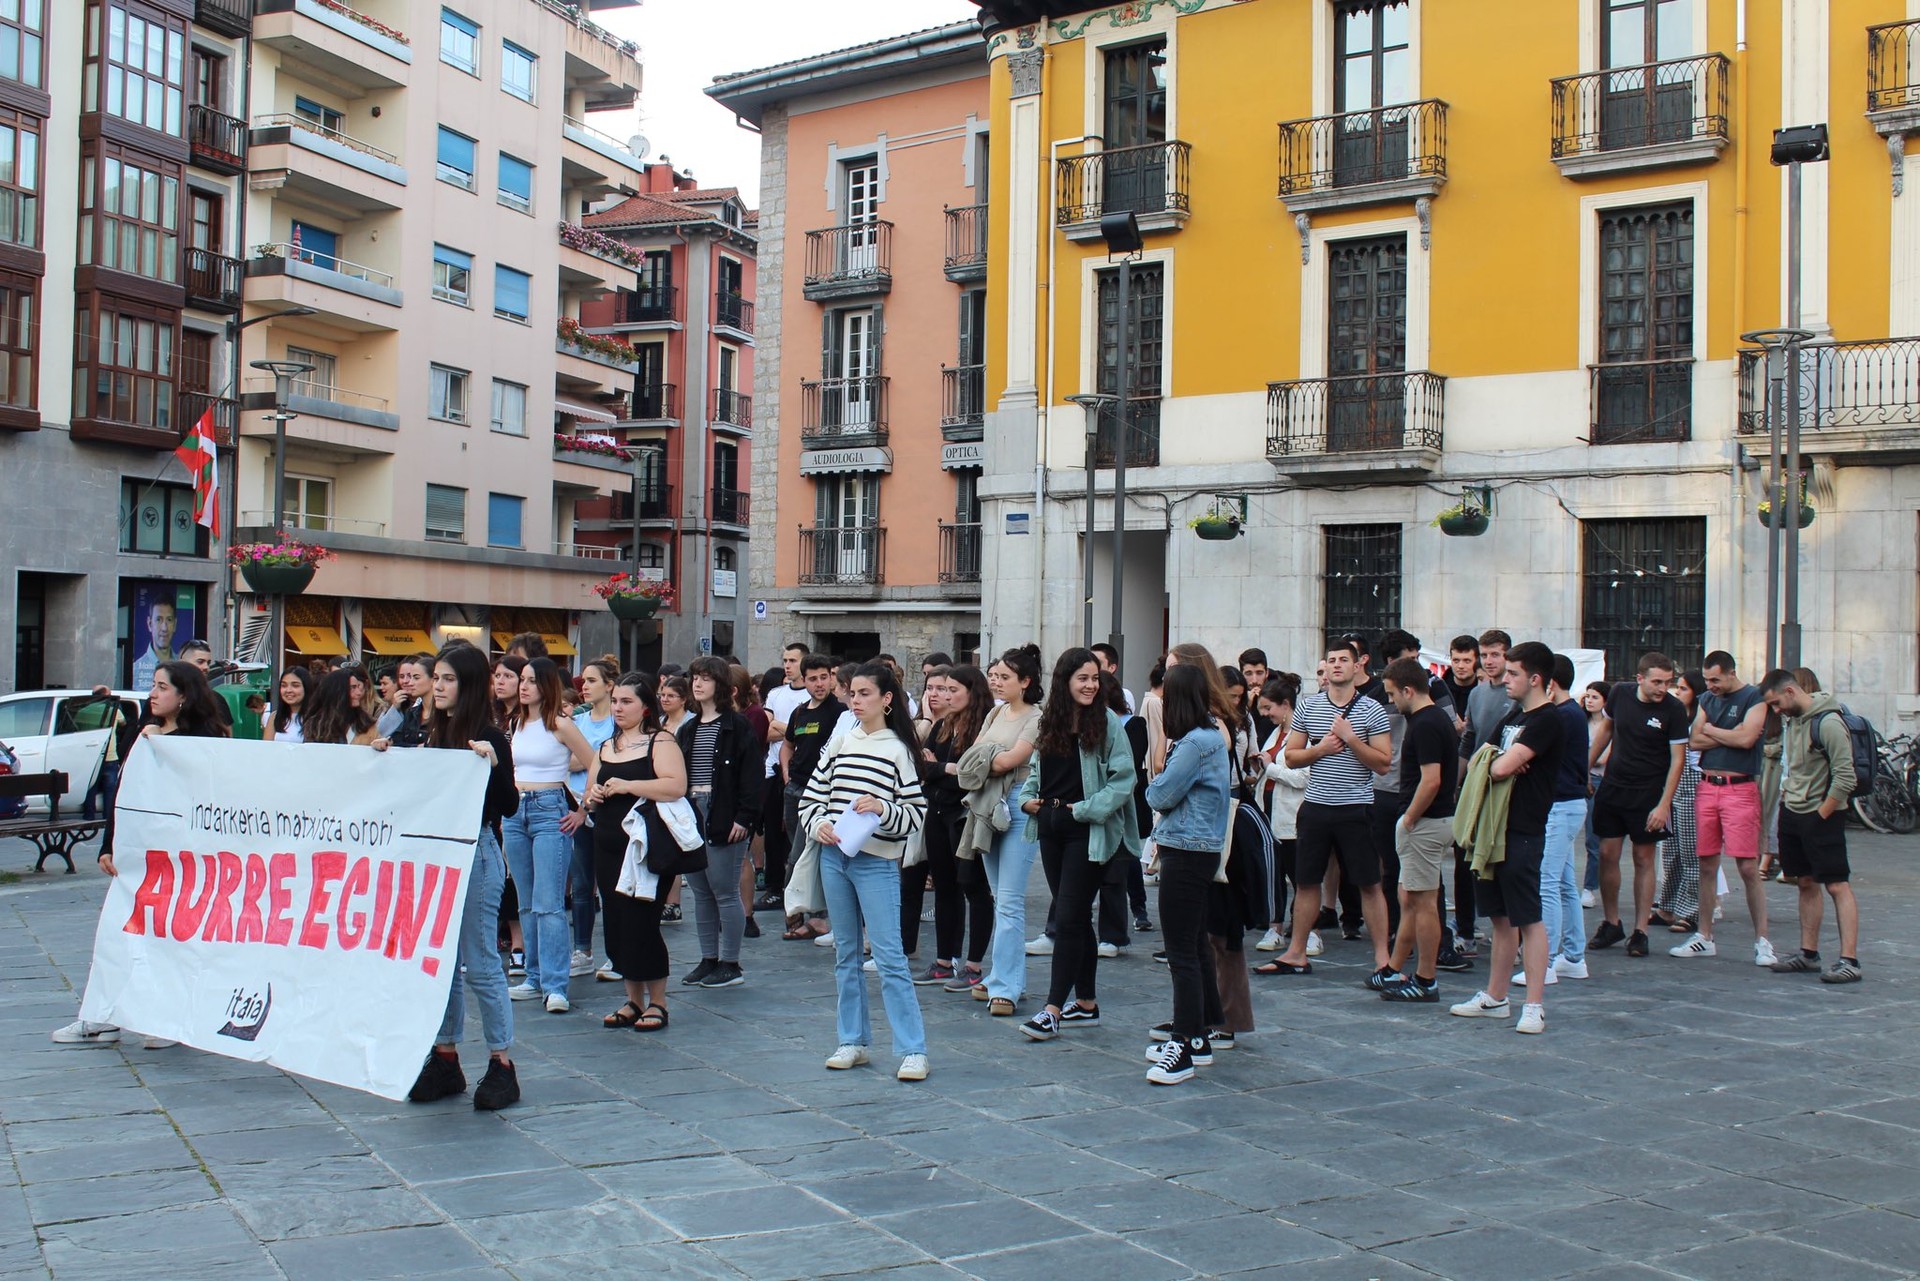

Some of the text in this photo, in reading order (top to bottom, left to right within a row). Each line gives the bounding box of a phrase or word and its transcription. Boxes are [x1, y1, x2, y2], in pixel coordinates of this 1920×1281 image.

[812, 452, 864, 465] AUDIOLOGIA
[945, 446, 979, 459] OPTICA
[191, 797, 393, 846] indarkeria matxista orori
[122, 850, 461, 978] AURRE EGIN!
[225, 987, 264, 1022] itaia
